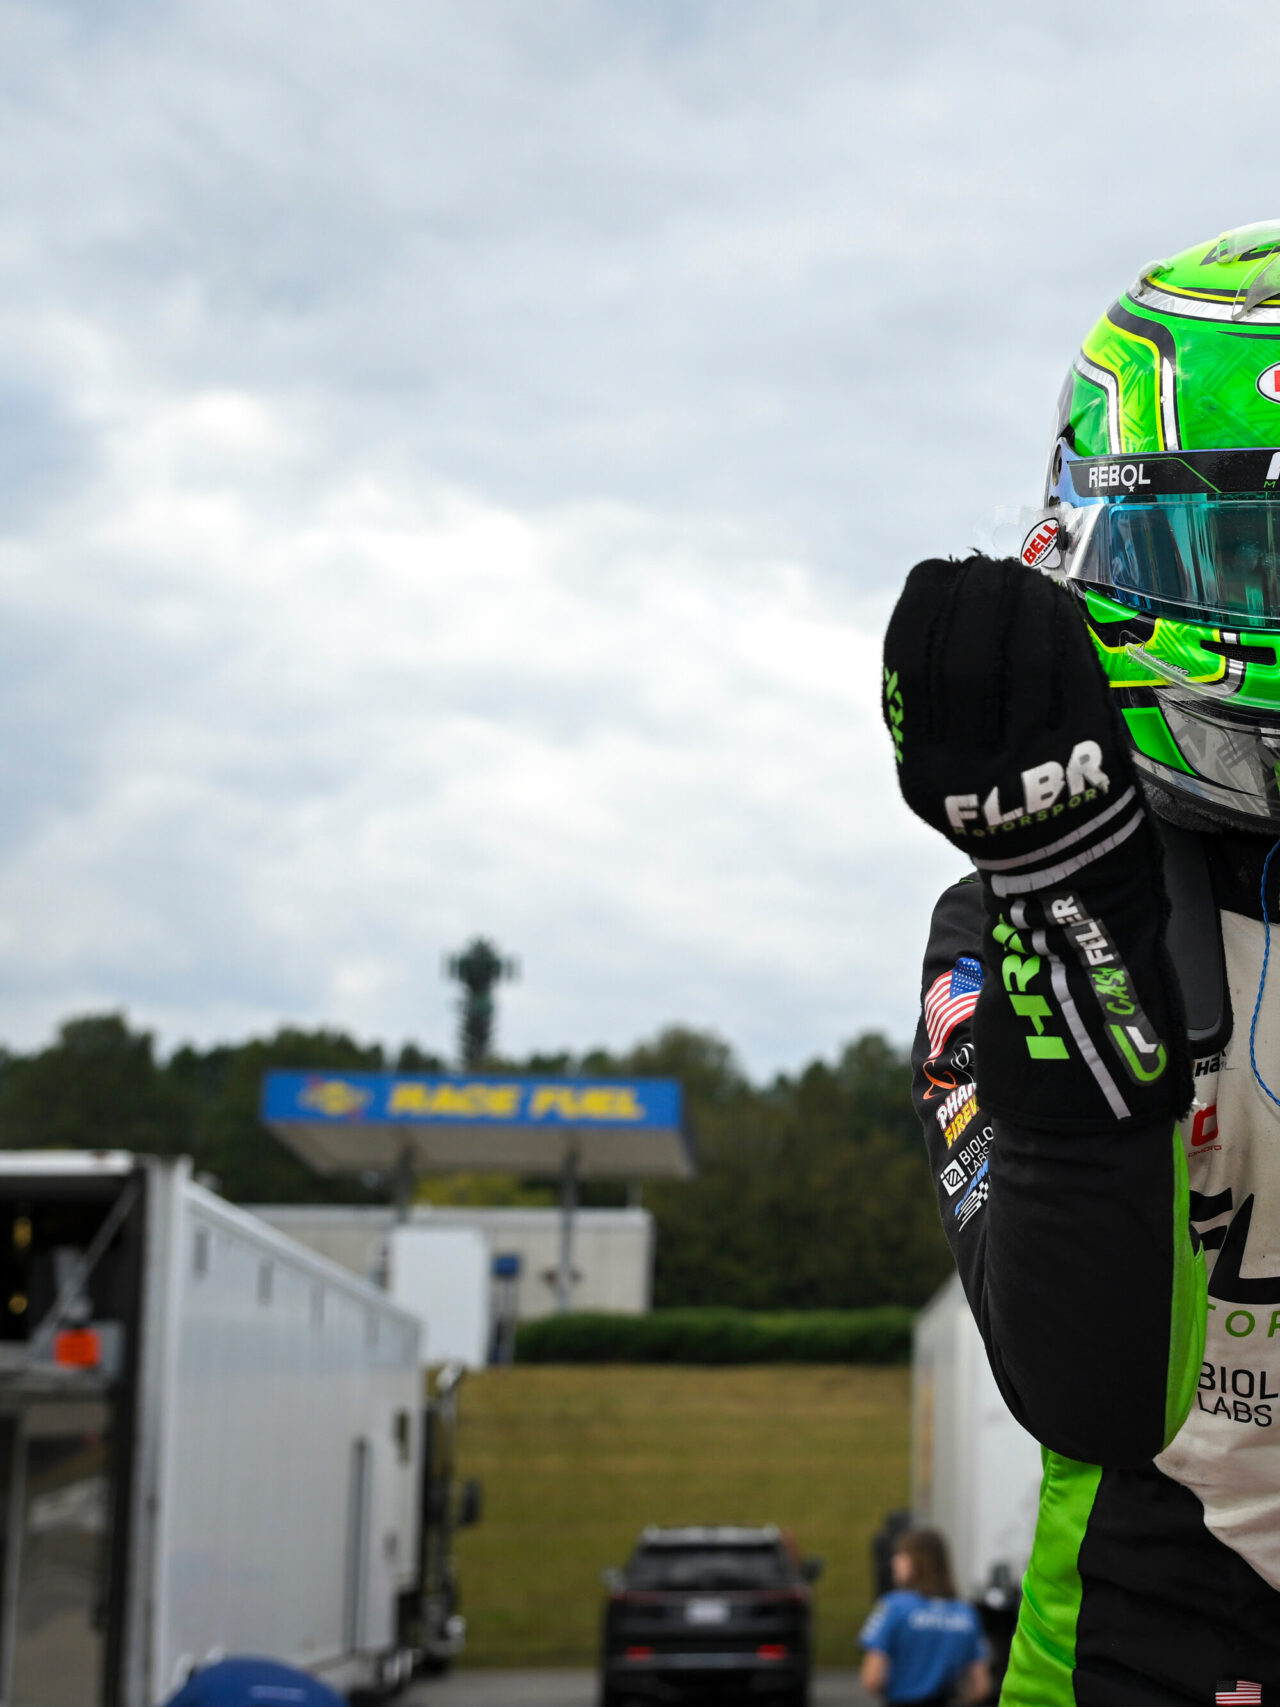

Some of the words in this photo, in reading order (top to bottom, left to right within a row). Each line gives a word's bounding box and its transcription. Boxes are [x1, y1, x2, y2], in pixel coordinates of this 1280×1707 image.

[1088, 463, 1151, 488] REBOL
[1022, 524, 1059, 566] BELL
[945, 740, 1110, 828] FLBR
[388, 1081, 521, 1117] RACE
[531, 1085, 645, 1120] FUEL
[1197, 1391, 1273, 1428] LABS
